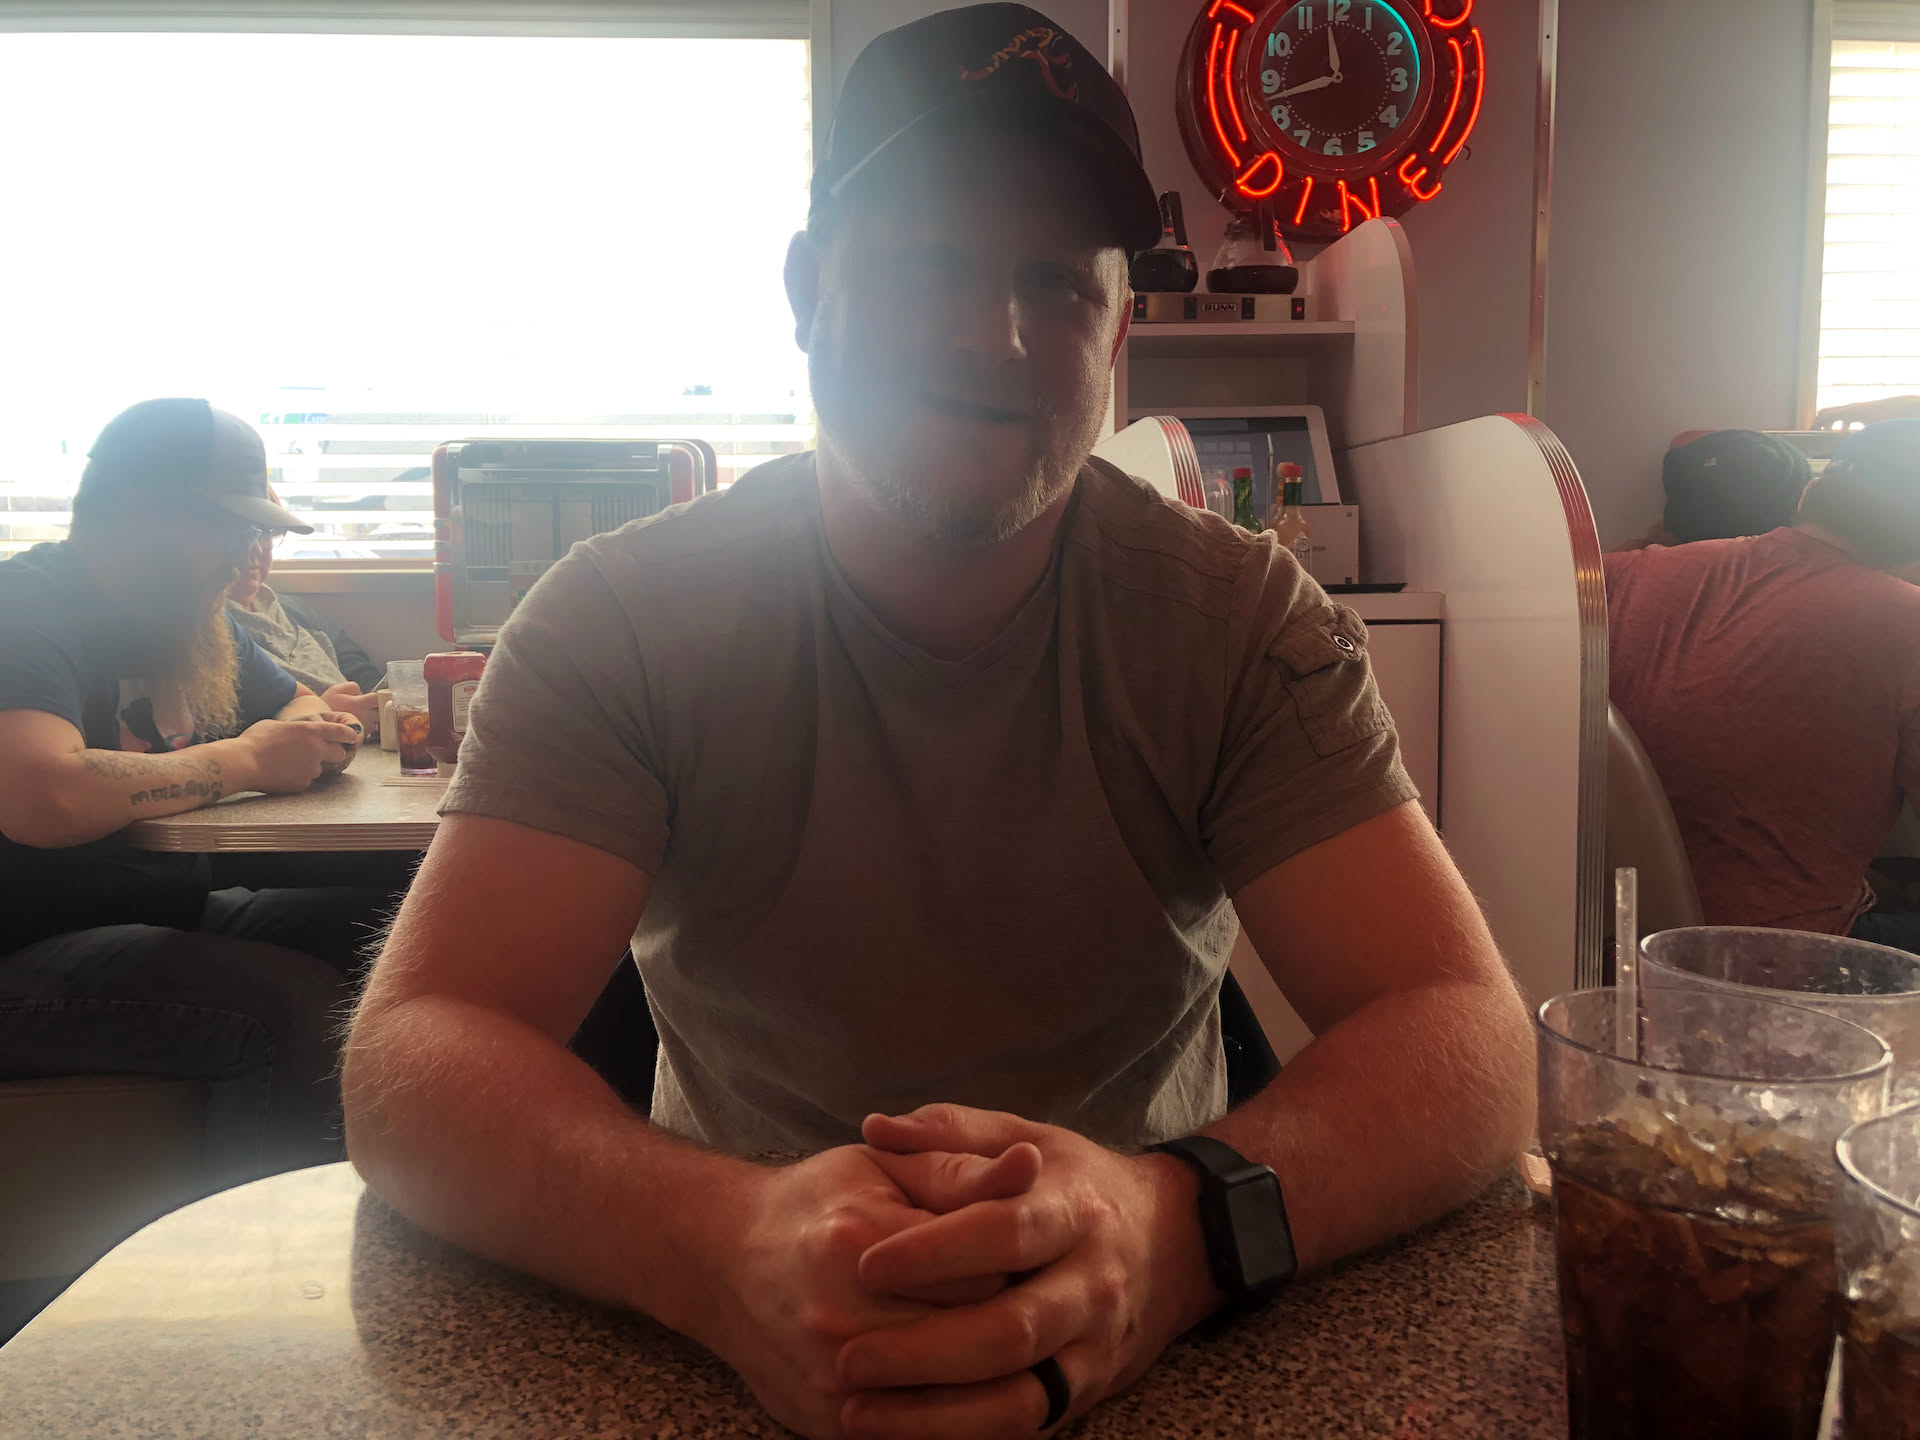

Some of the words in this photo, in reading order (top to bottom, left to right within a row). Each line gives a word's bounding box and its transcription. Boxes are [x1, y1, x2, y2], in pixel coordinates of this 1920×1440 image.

[1298, 6, 1313, 30] 11
[1327, 0, 1351, 21] 12
[1365, 7, 1372, 30] 1
[1268, 32, 1291, 57] 10
[1387, 31, 1403, 56] 2
[1261, 69, 1280, 94] 9
[1390, 67, 1408, 92] 3
[1270, 104, 1291, 131] 8
[1379, 105, 1399, 128] 4
[1293, 129, 1311, 148] 7
[1323, 137, 1343, 156] 6
[1357, 131, 1376, 153] 5
[1235, 150, 1443, 233] DINE
[1202, 303, 1238, 312] BUNN
